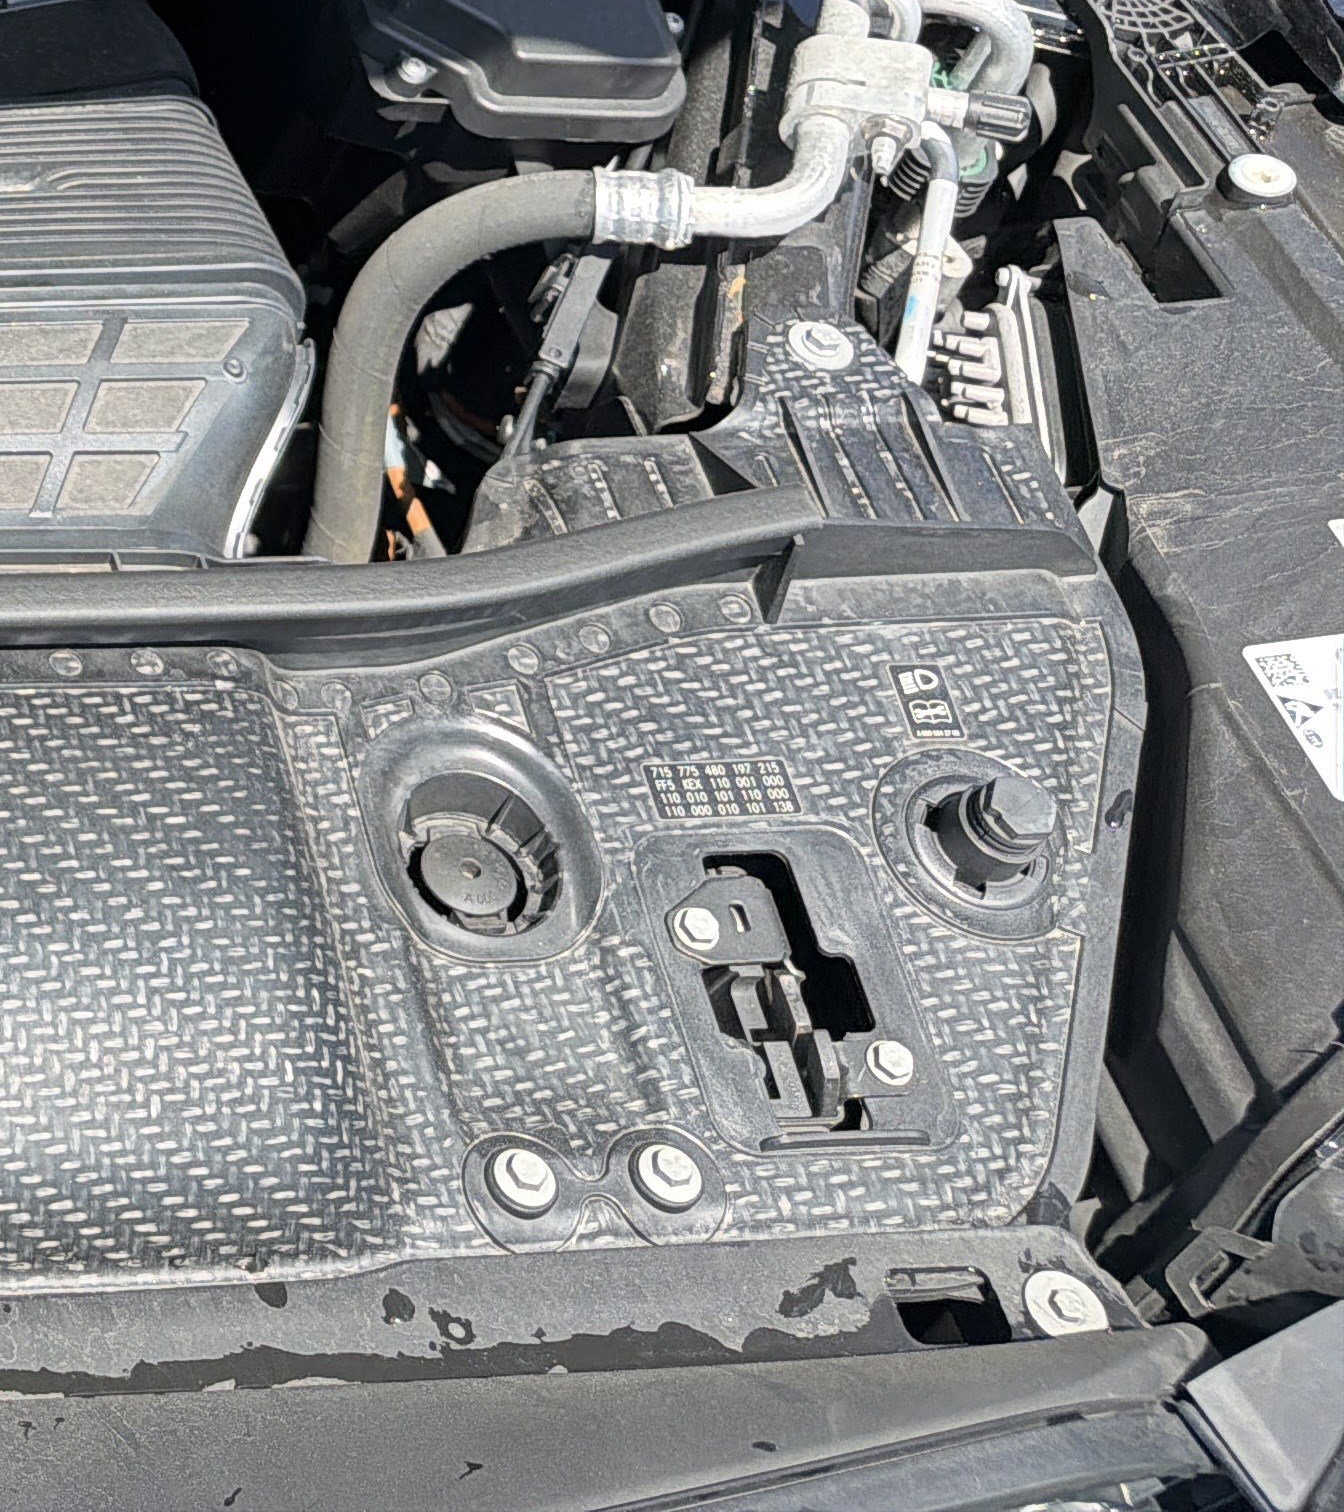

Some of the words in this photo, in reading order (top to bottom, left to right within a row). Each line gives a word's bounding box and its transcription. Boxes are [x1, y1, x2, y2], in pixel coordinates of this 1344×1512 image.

[650, 766, 673, 778] 715
[676, 765, 700, 777] 775
[757, 761, 780, 774] 215
[654, 779, 676, 792] FF5
[709, 777, 731, 789] 110
[735, 776, 757, 788] 001
[762, 774, 785, 787] 000
[660, 792, 681, 804] 110
[685, 791, 709, 803] 010
[714, 790, 735, 802] 101
[741, 789, 763, 801] 110
[766, 787, 790, 800] 000
[664, 805, 686, 817] 110
[690, 804, 713, 816] 000
[717, 803, 740, 815] 010
[745, 802, 767, 814] 101
